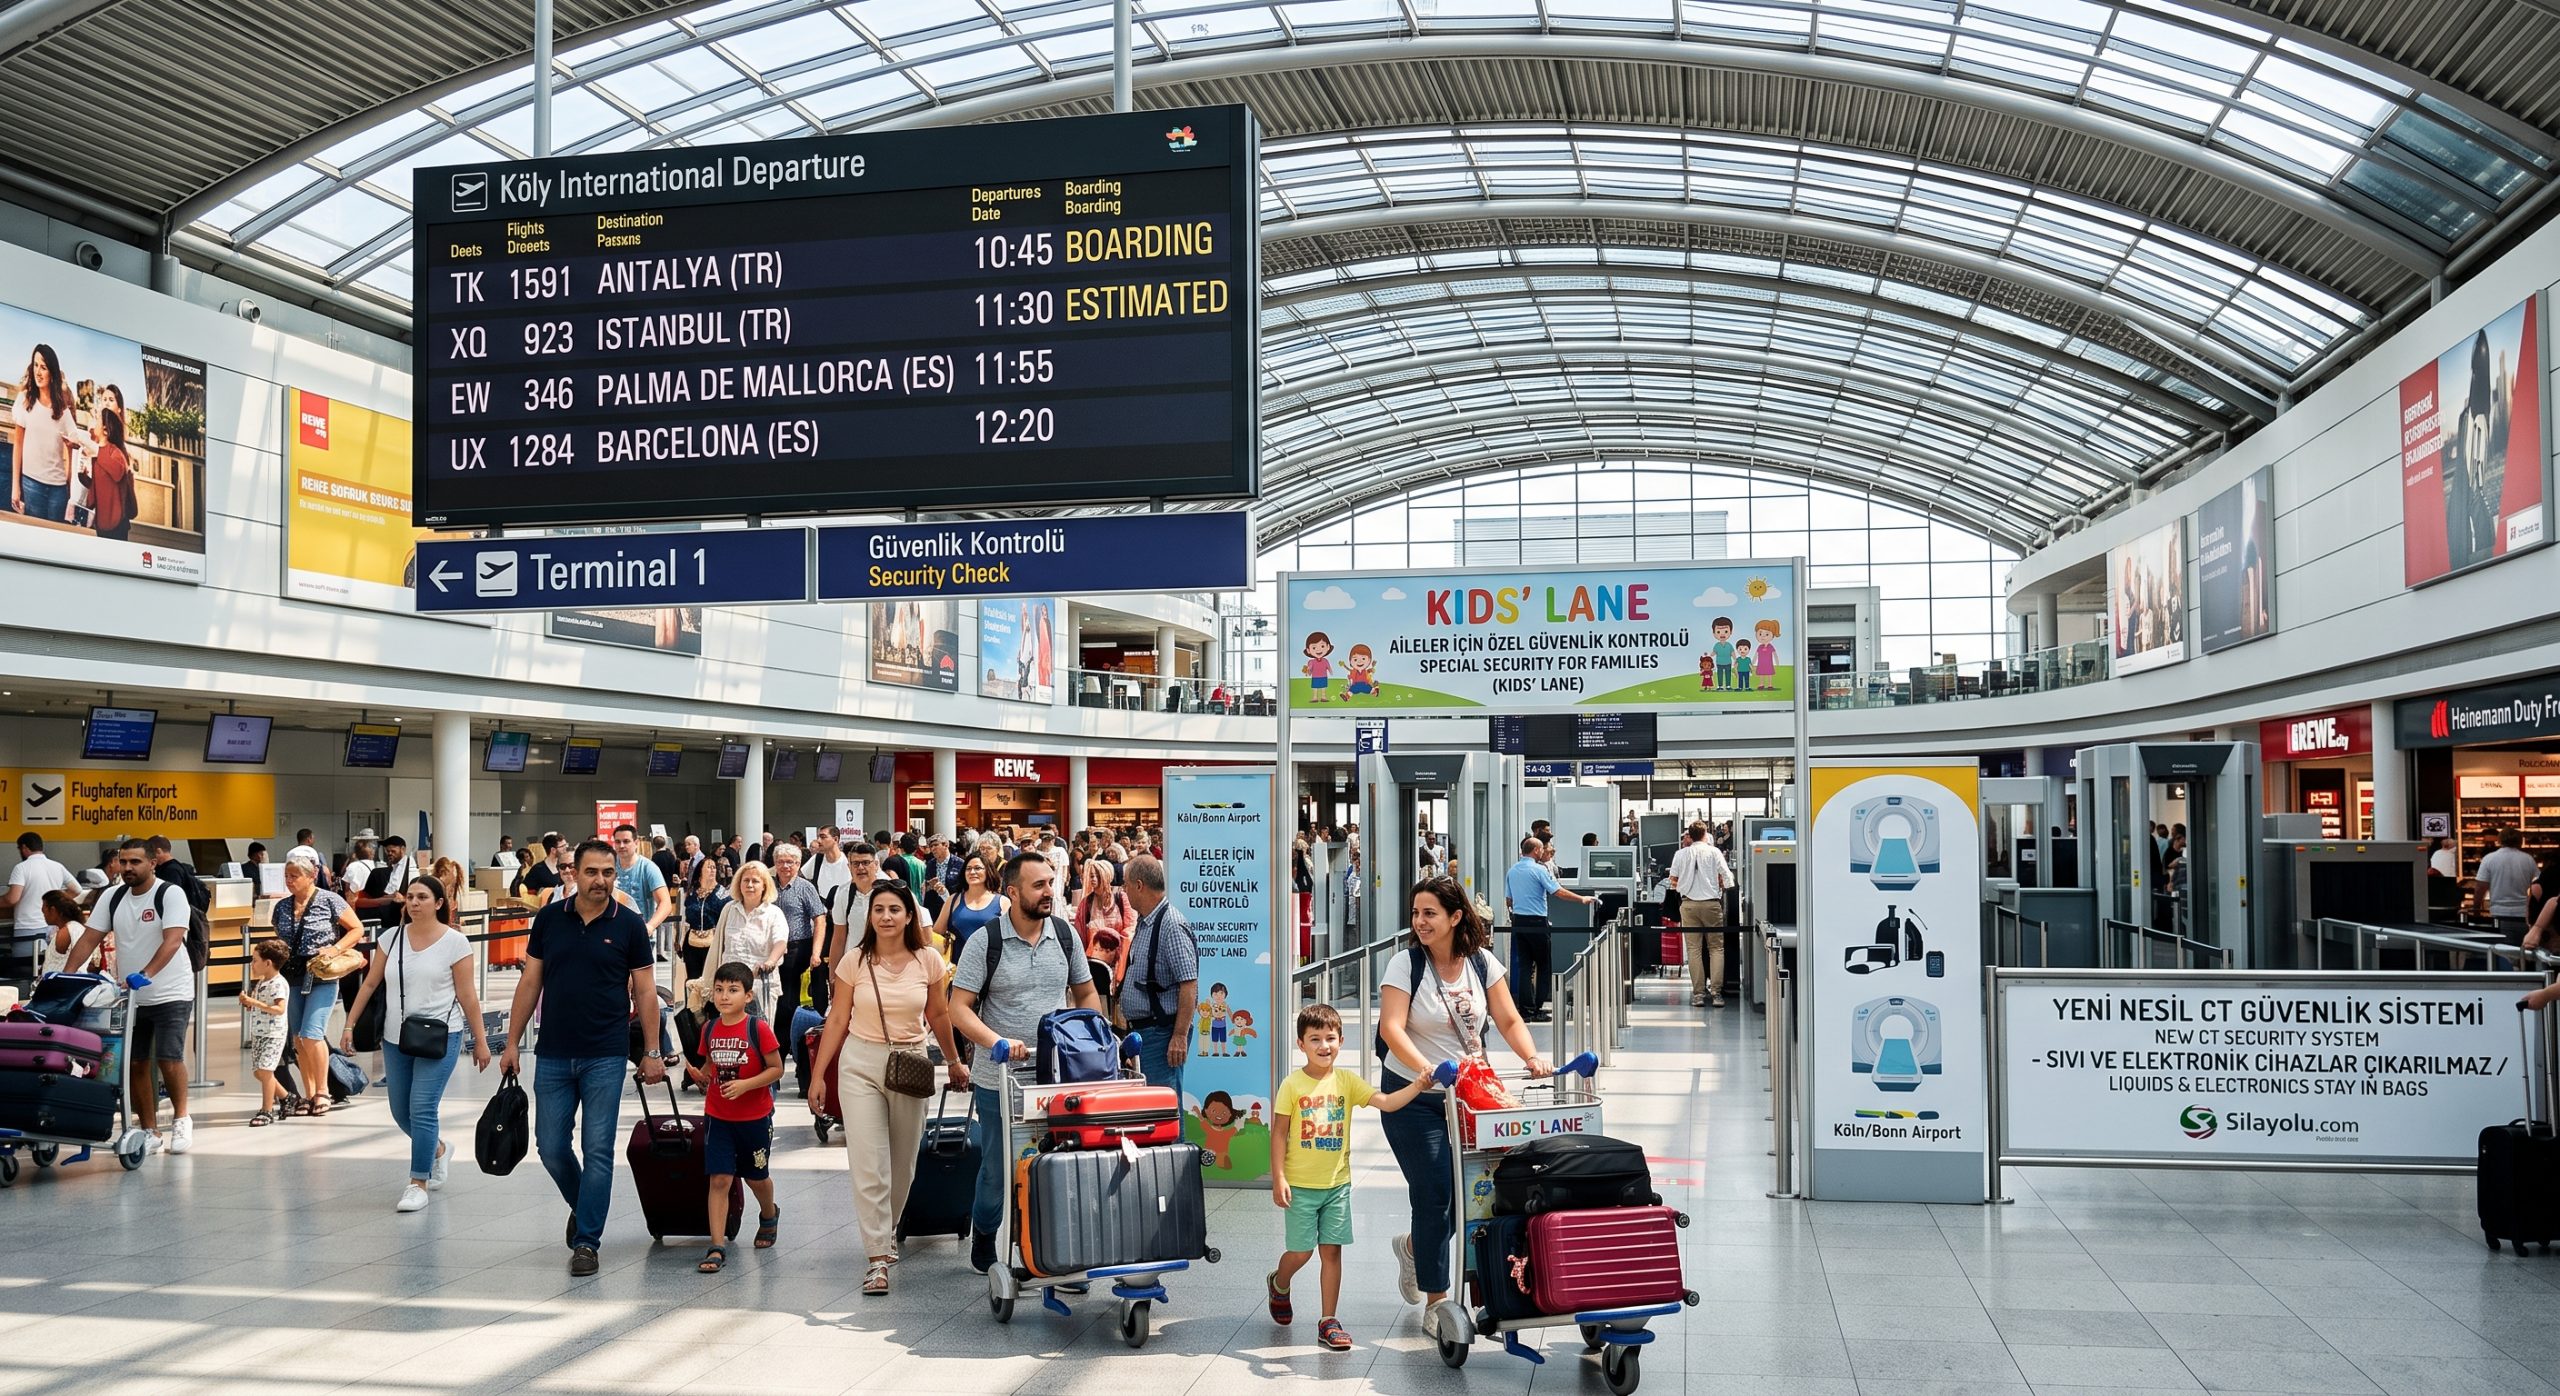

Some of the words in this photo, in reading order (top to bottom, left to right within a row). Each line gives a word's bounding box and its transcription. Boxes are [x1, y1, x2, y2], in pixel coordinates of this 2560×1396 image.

[500, 172, 552, 207] Köly
[560, 158, 722, 198] International
[733, 153, 865, 190] Departure
[1065, 179, 1122, 197] Boarding
[972, 185, 1041, 205] Departures
[972, 206, 1001, 222] Date
[1065, 198, 1122, 216] Boarding
[508, 222, 545, 239] Flights
[597, 213, 664, 230] Destination
[450, 244, 483, 259] Deets
[508, 239, 550, 254] Dreeets
[451, 271, 485, 303] TK
[509, 265, 570, 300] 1591
[598, 255, 722, 295] ANTALYA
[730, 250, 783, 292] (TR)
[975, 232, 1053, 269] 10:45
[1066, 221, 1213, 263] BOARDING
[450, 326, 487, 359] XQ
[524, 321, 573, 356] 923
[598, 311, 730, 351] ISTANBUL
[739, 306, 792, 348] (TR)
[975, 290, 1053, 327] 11:30
[1066, 280, 1228, 322] ESTIMATED
[451, 381, 490, 415] EW
[524, 376, 573, 412] 346
[598, 370, 691, 407] PALMA
[701, 367, 734, 402] DE
[743, 358, 894, 399] MALLORCA
[902, 354, 955, 395] (ES)
[975, 349, 1054, 386] 11:55
[451, 437, 487, 471] UX
[510, 433, 575, 468] 1284
[598, 422, 759, 463] BARCELONA
[768, 419, 819, 460] (ES)
[975, 407, 1054, 444] 12:20
[869, 531, 964, 560] Güvenlik
[971, 528, 1065, 556] Kontrolü
[530, 548, 676, 592] Terminal
[693, 548, 706, 585] 1
[868, 563, 946, 591] Security
[951, 561, 1010, 585] Check
[1546, 583, 1650, 623] LANE
[1389, 634, 1450, 655] AİLELER
[1453, 633, 1485, 656] İÇİN
[1488, 631, 1524, 653] ÖZEL
[1528, 630, 1604, 651] GÜVENLİK
[1608, 628, 1690, 649] KONTROLÜ
[1420, 657, 1480, 674] SPECIAL
[1484, 656, 1554, 672] SECURITY
[1557, 655, 1587, 672] FOR
[1590, 653, 1659, 671] FAMILIES
[1540, 675, 1585, 694] LANE)
[2452, 706, 2511, 730] Heinemann
[2514, 699, 2542, 728] Duty
[2545, 694, 2560, 719] Fr
[994, 758, 1034, 777] REWE
[72, 781, 133, 802] Flughafen
[137, 783, 177, 801] Kirport
[72, 805, 133, 825] Flughafen
[138, 805, 198, 823] Köln/Bonn
[1183, 846, 1229, 860] AİLELER
[1233, 846, 1255, 863] İÇİN
[1217, 922, 1259, 931] SECURITY
[1221, 948, 1248, 958] LANE)
[2052, 993, 2112, 1021] YENİ
[2119, 993, 2193, 1023] NESİL
[2200, 999, 2230, 1023] CT
[2240, 994, 2372, 1025] GÜVENLİK
[2378, 995, 2484, 1026] SİSTEMİ
[2155, 1029, 2194, 1045] NEW
[2199, 1029, 2220, 1045] CT
[2224, 1029, 2308, 1047] SECURITY
[2311, 1031, 2379, 1047] SYSTEM
[2046, 1051, 2086, 1069] SIVI
[2091, 1052, 2117, 1069] VE
[2122, 1048, 2249, 1072] ELEKTRONİK
[2255, 1049, 2358, 1074] CİHAZLAR
[2364, 1054, 2490, 1079] ÇIKARILMAZ
[2496, 1056, 2508, 1077] /
[2109, 1076, 2174, 1094] LIQUIDS
[2178, 1077, 2191, 1093] &
[2195, 1077, 2309, 1095] ELECTRONICS
[2313, 1079, 2356, 1095] STAY
[2360, 1079, 2378, 1096] IN
[2383, 1080, 2428, 1097] BAGS
[1540, 1117, 1583, 1135] LANE
[1834, 1123, 1908, 1140] Köln/Bonn
[1912, 1124, 1962, 1142] Airport
[2226, 1112, 2359, 1137] Silayolu.com
